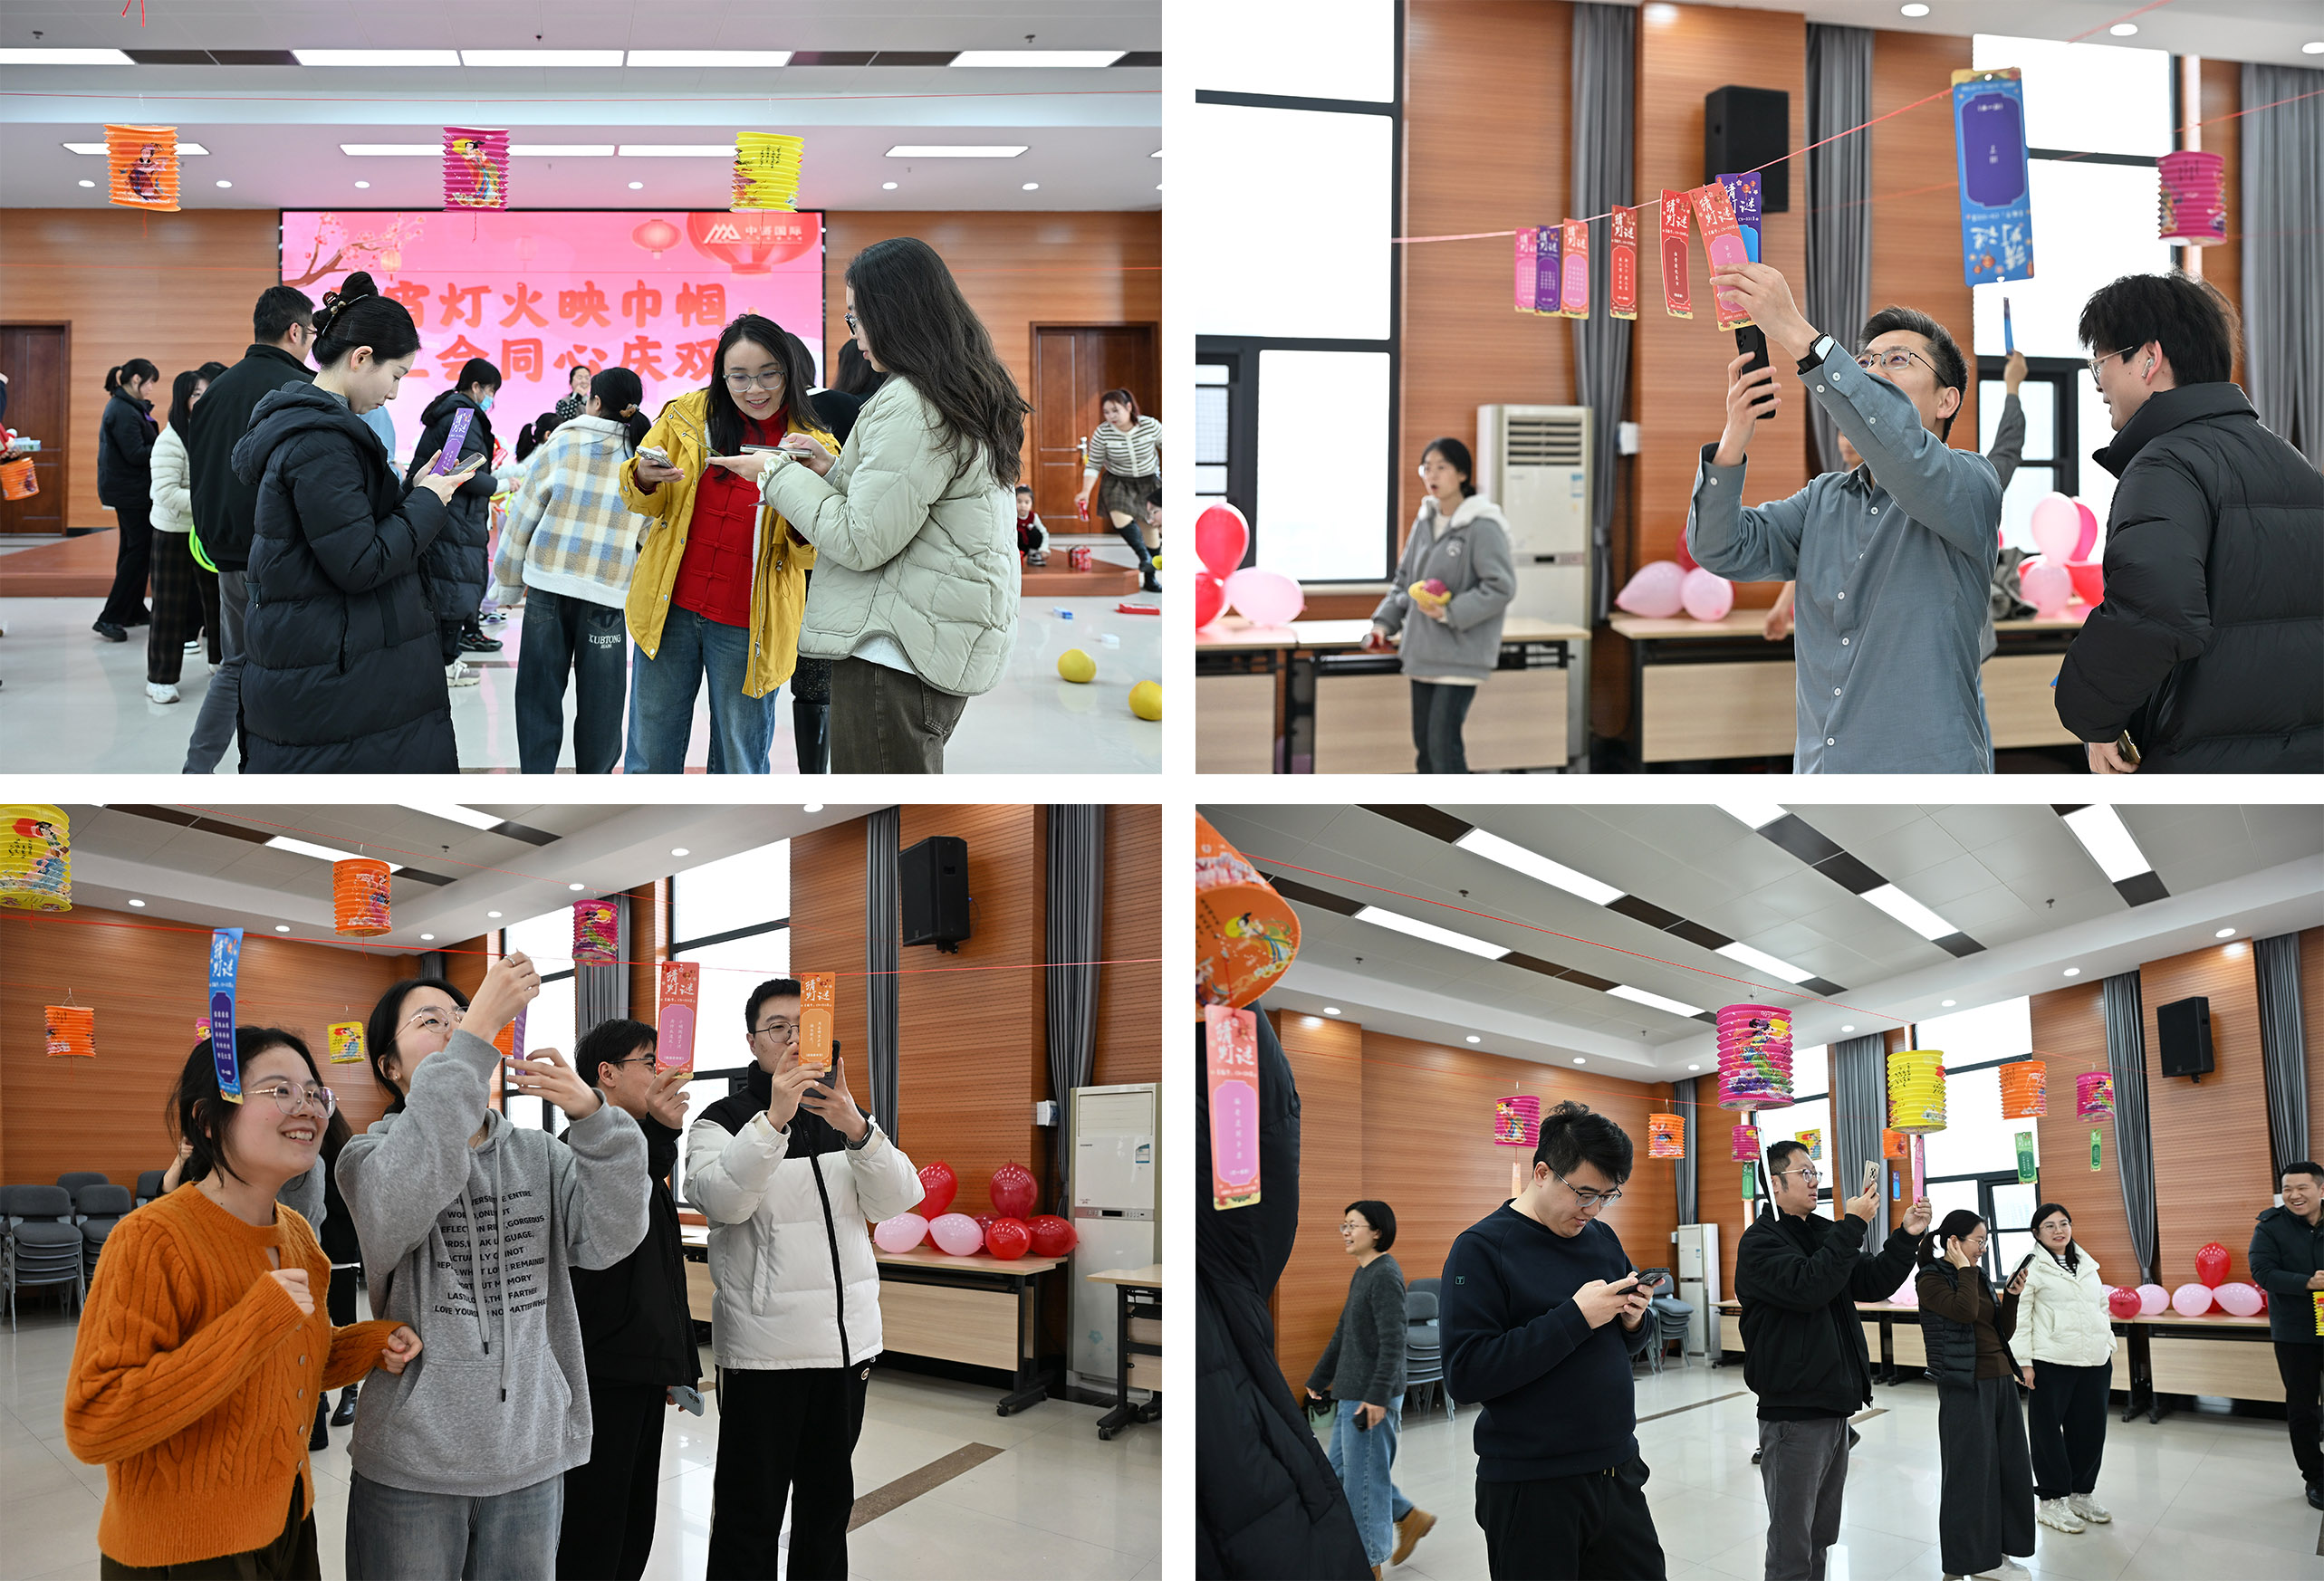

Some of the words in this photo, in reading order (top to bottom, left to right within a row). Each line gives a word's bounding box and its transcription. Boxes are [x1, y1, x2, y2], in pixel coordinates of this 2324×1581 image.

[1666, 198, 1688, 229] 猜灯谜
[1699, 194, 1734, 225] 猜灯谜
[333, 280, 726, 329] 宵灯火映巾帼
[665, 968, 695, 995] 猜灯谜
[804, 979, 831, 1001] 猜灯谜
[508, 1190, 533, 1201] ENTIRE
[460, 1268, 485, 1277] WHT
[510, 1257, 545, 1270] REMAINED
[495, 1274, 532, 1287] MMORY
[434, 1305, 453, 1315] LOVE
